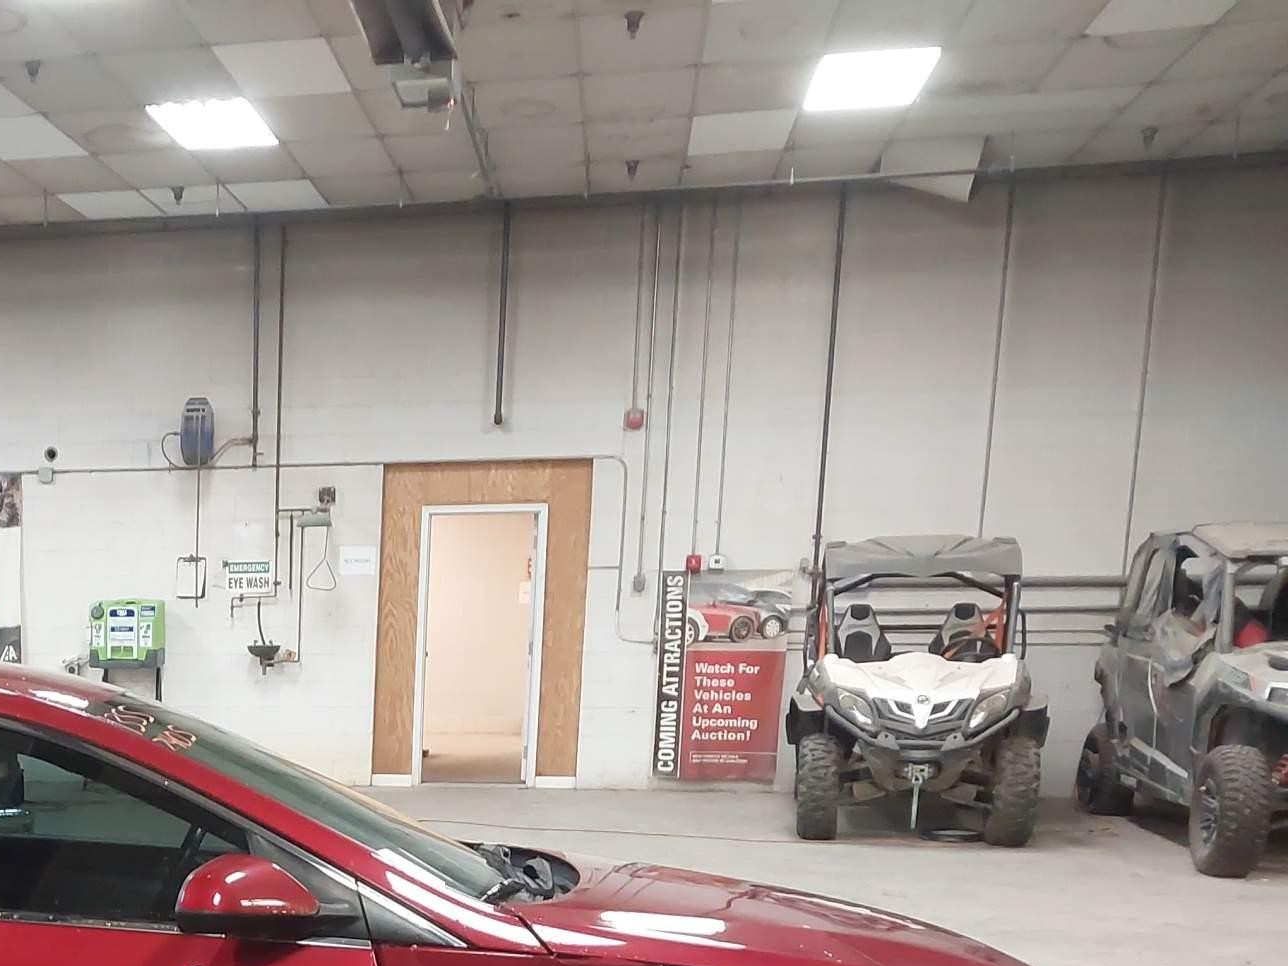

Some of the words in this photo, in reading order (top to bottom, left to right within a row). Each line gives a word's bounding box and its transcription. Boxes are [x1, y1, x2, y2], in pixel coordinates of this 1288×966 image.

[229, 563, 269, 572] EMERGENCY
[228, 577, 243, 589] EYE
[246, 576, 270, 589] WASH
[662, 575, 684, 696] ATTRACTIONS
[695, 663, 735, 674] Watch
[739, 663, 760, 674] For
[694, 676, 735, 687] These
[694, 690, 752, 701] Vehicles
[692, 703, 708, 713] At
[712, 703, 731, 713] An
[692, 717, 758, 729] Upcoming
[657, 700, 678, 772] COMING
[691, 730, 751, 741] Auction!
